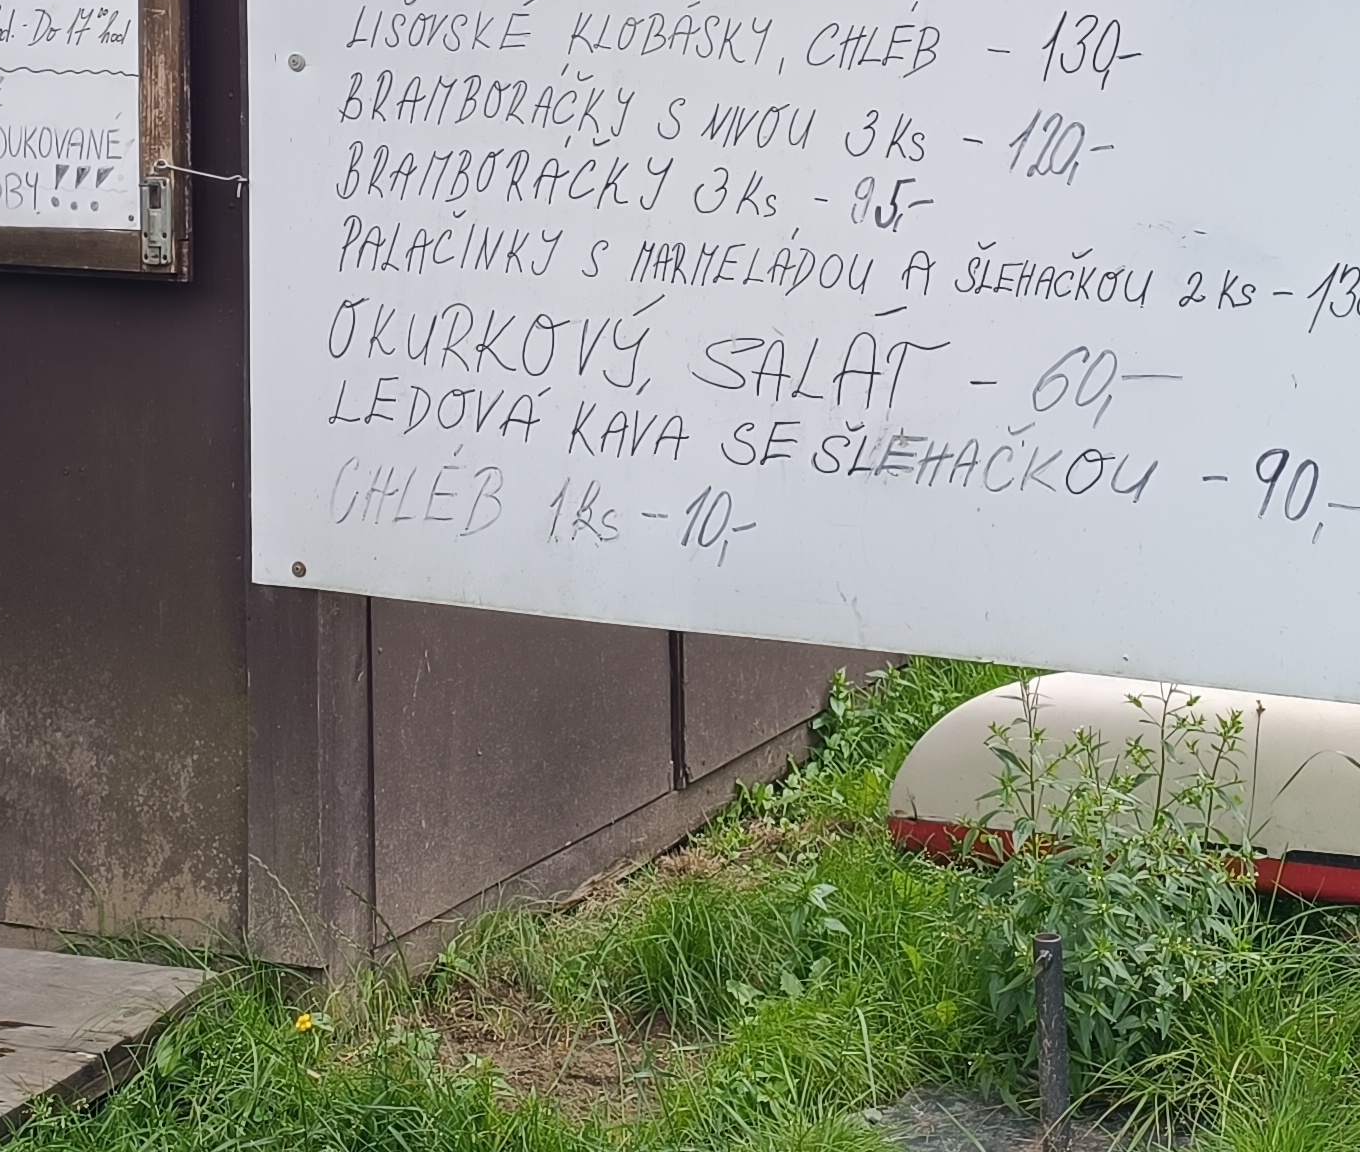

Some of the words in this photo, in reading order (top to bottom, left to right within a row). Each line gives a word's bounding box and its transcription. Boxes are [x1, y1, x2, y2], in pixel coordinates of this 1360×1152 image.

[806, 0, 941, 78] CHLÉB
[339, 63, 635, 138] BRAMBORÁČKY
[656, 97, 686, 140] S
[700, 103, 817, 149] NIVOU
[339, 209, 564, 276] PALAČINKY
[581, 239, 609, 278] S
[629, 227, 874, 297] MARMELÁDOU
[901, 250, 937, 296] A
[955, 240, 1154, 309] ŠLEHAČKOU
[328, 294, 666, 388] OKURKOVÝ
[691, 305, 951, 410] SALÁT
[328, 376, 552, 443] LEDOVÁ
[329, 443, 504, 538] CHLÉB
